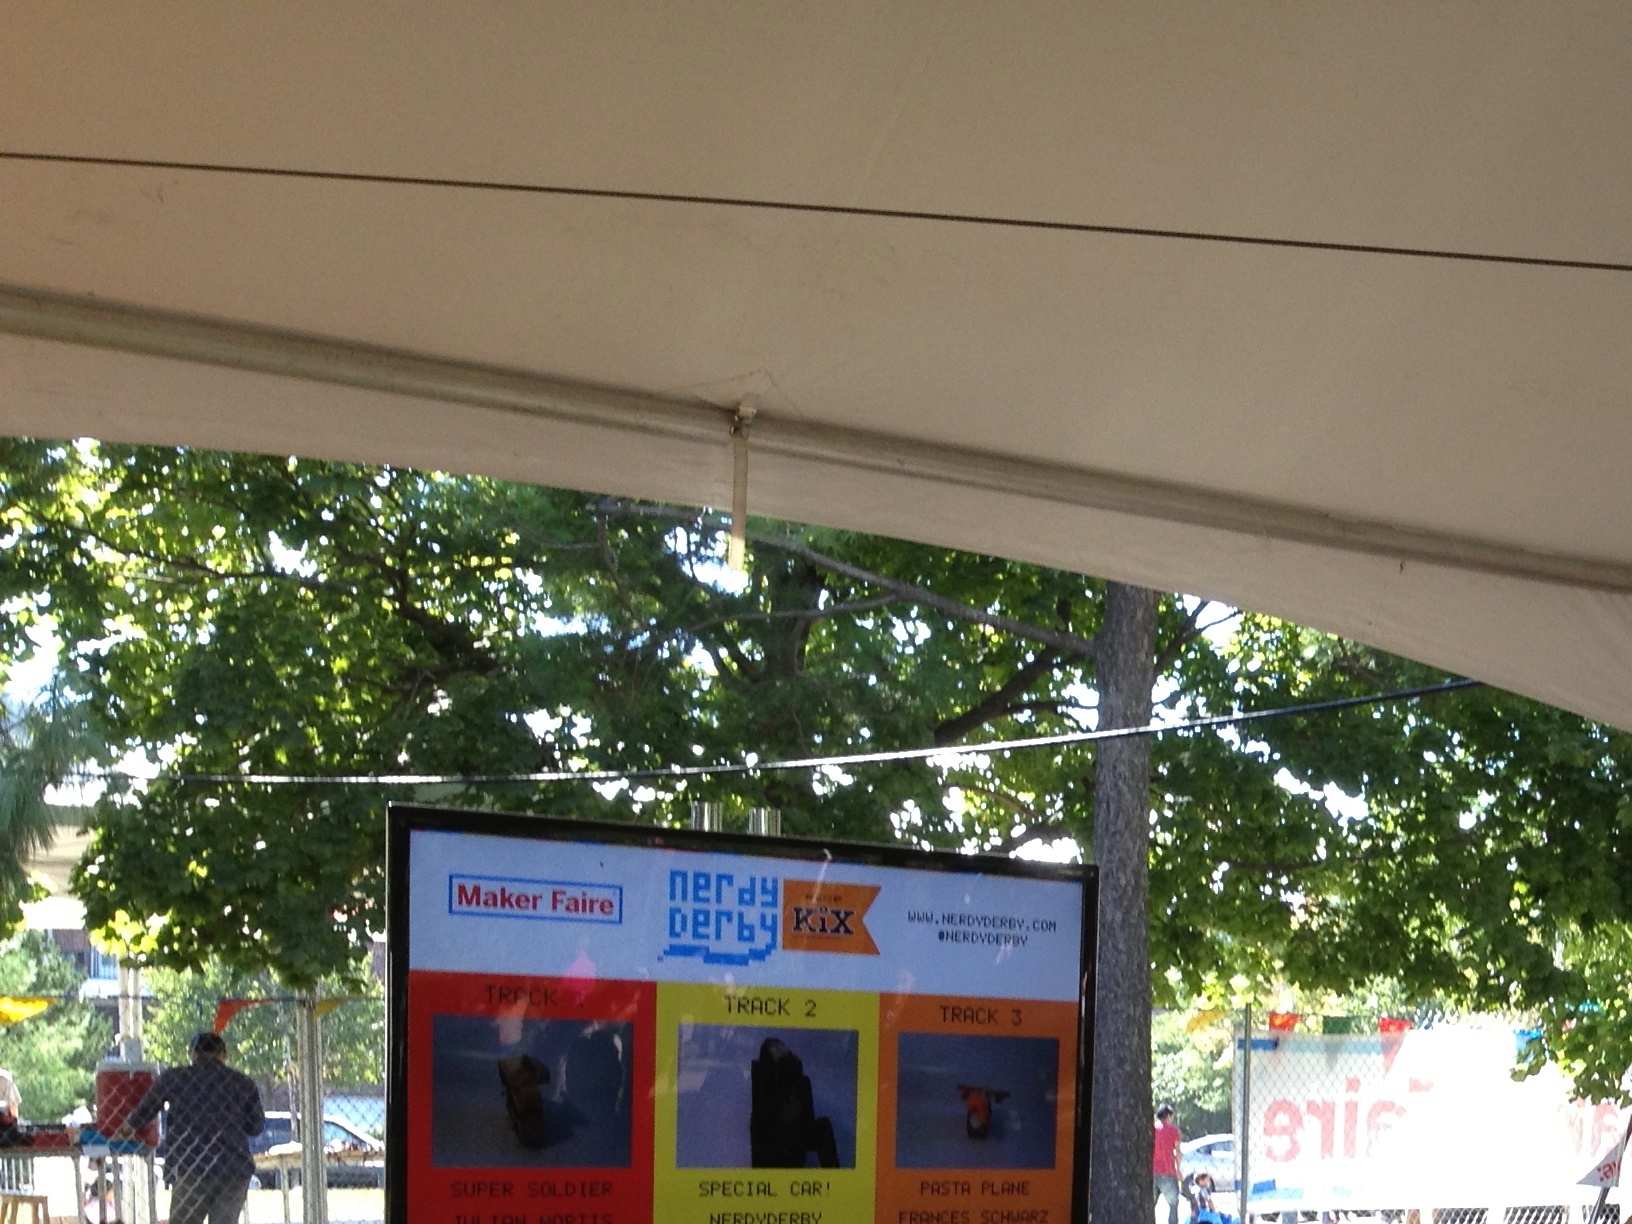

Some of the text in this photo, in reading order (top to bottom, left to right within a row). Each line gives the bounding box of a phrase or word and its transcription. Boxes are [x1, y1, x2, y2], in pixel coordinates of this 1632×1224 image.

[457, 883, 614, 916] Maker Faire
[907, 909, 1057, 933] WWW.NERDYDERBY.COM
[937, 930, 1028, 948] @NERDYDERBY
[724, 994, 817, 1018] TRACK 2
[939, 1005, 1023, 1026] TRACK 3
[451, 1180, 613, 1198] SUPER SOLDIER
[699, 1180, 831, 1198] SPECIAL CAR!
[920, 1180, 1030, 1197] PASTA PLANE
[980, 1209, 1049, 1224] SCHWARZ
